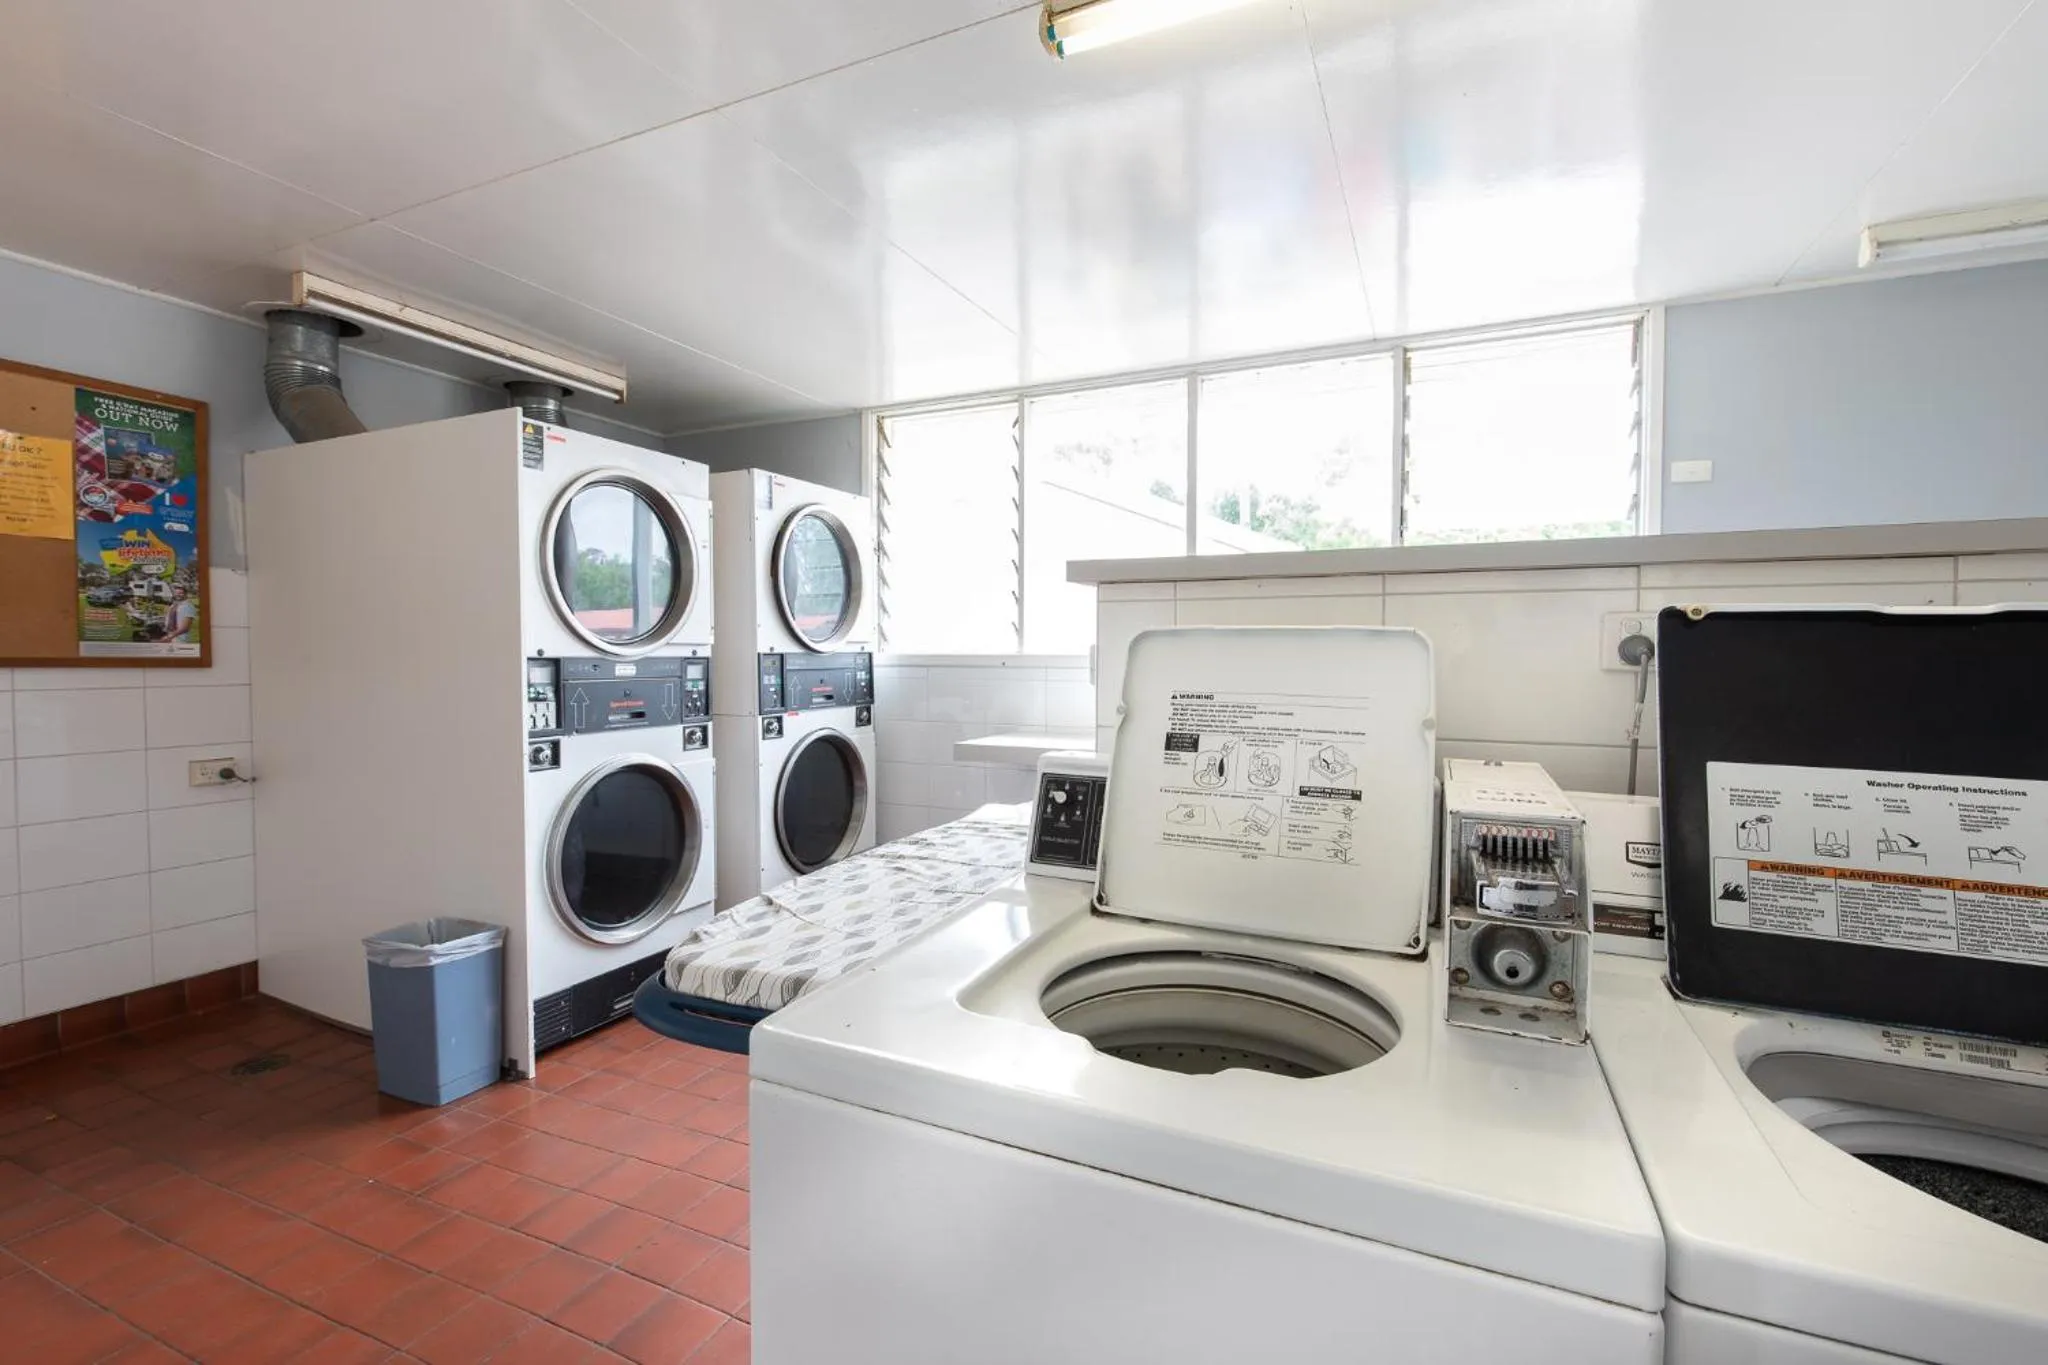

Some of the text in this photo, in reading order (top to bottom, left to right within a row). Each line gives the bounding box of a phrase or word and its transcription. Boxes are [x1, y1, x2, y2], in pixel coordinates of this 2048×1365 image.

[94, 407, 179, 433] OUT NOW
[1866, 780, 2028, 797] Washer Operating Instructions
[1769, 863, 1825, 876] WARNING
[1849, 871, 1951, 888] AVERTISSEMENT
